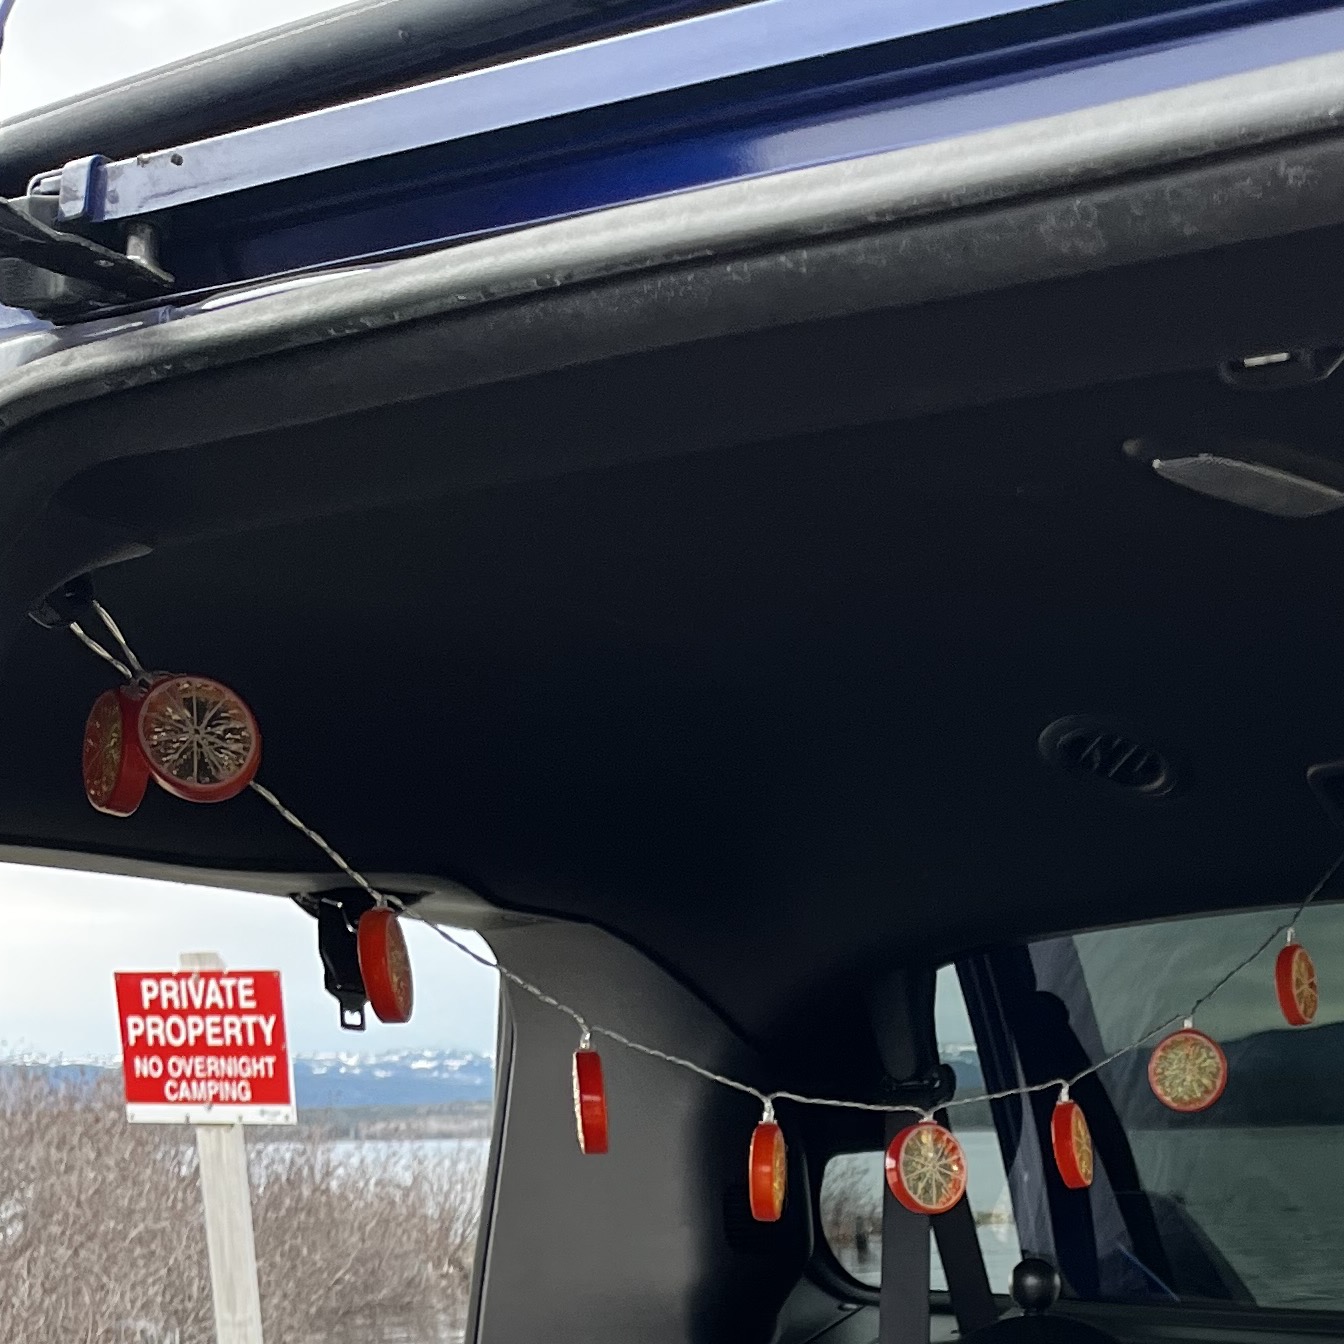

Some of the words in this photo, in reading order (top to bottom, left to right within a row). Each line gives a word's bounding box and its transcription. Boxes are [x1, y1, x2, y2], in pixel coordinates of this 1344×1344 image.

[140, 978, 257, 1010] PRIVATE
[126, 1015, 276, 1047] PROPERTY
[134, 1056, 163, 1078] NO
[167, 1056, 276, 1078] OVERNIGHT
[164, 1080, 252, 1102] CAMPING
